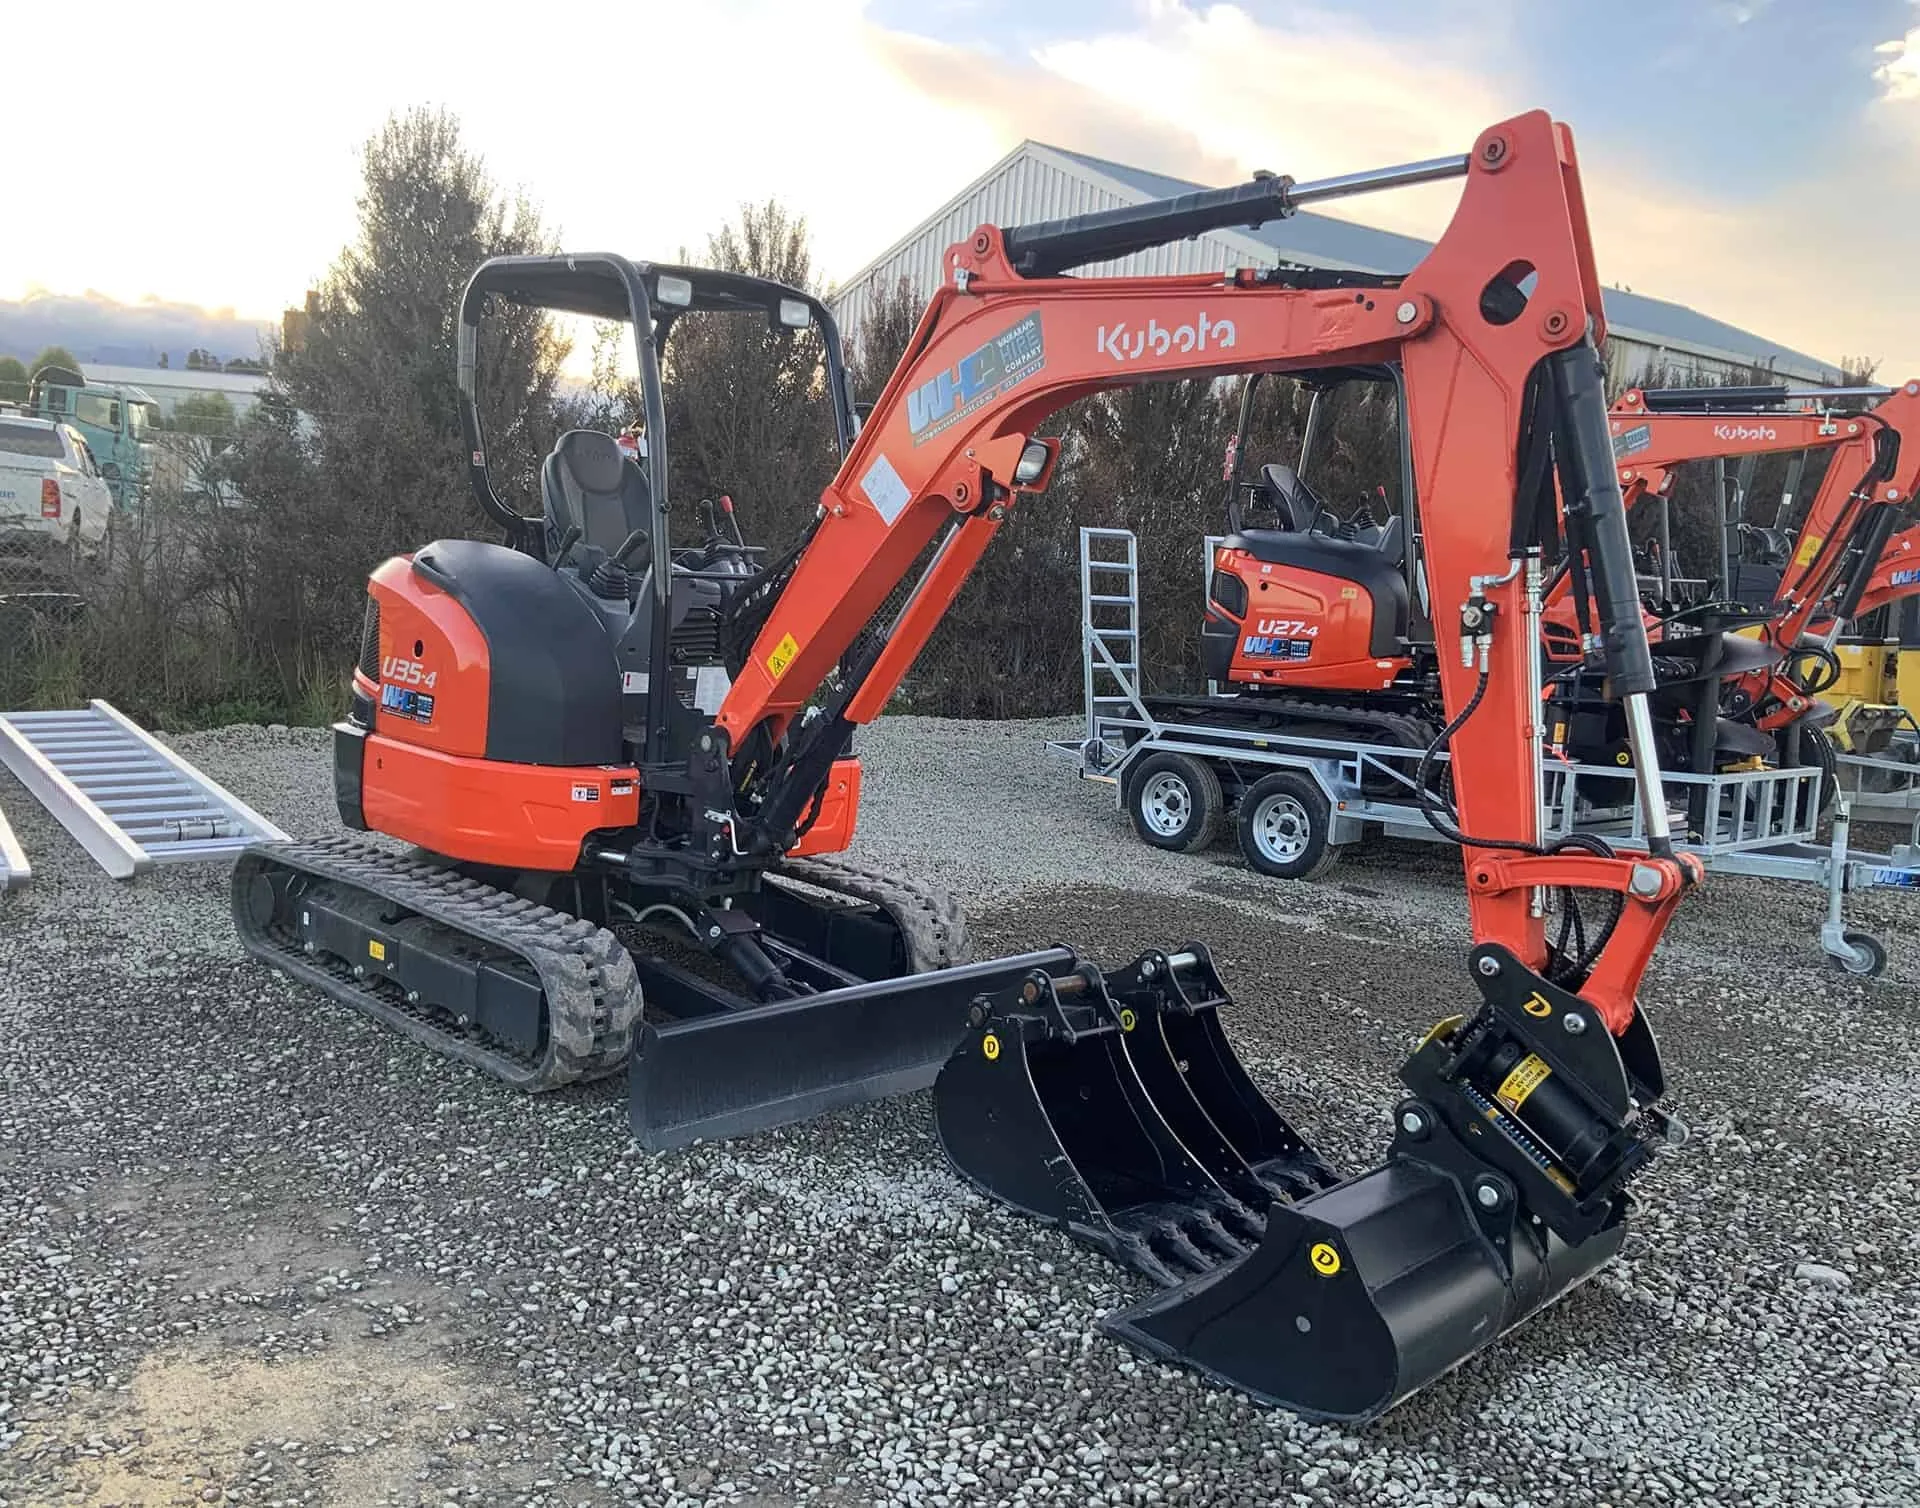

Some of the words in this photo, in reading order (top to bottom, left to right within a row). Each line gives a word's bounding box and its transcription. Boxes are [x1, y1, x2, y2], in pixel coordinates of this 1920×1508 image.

[1000, 331, 1041, 365] HIRE
[1097, 311, 1236, 361] Kubota
[1004, 345, 1042, 374] COMPANY
[1713, 424, 1777, 441] Kubota
[1257, 619, 1319, 637] U27-4
[382, 655, 438, 689] U35-4
